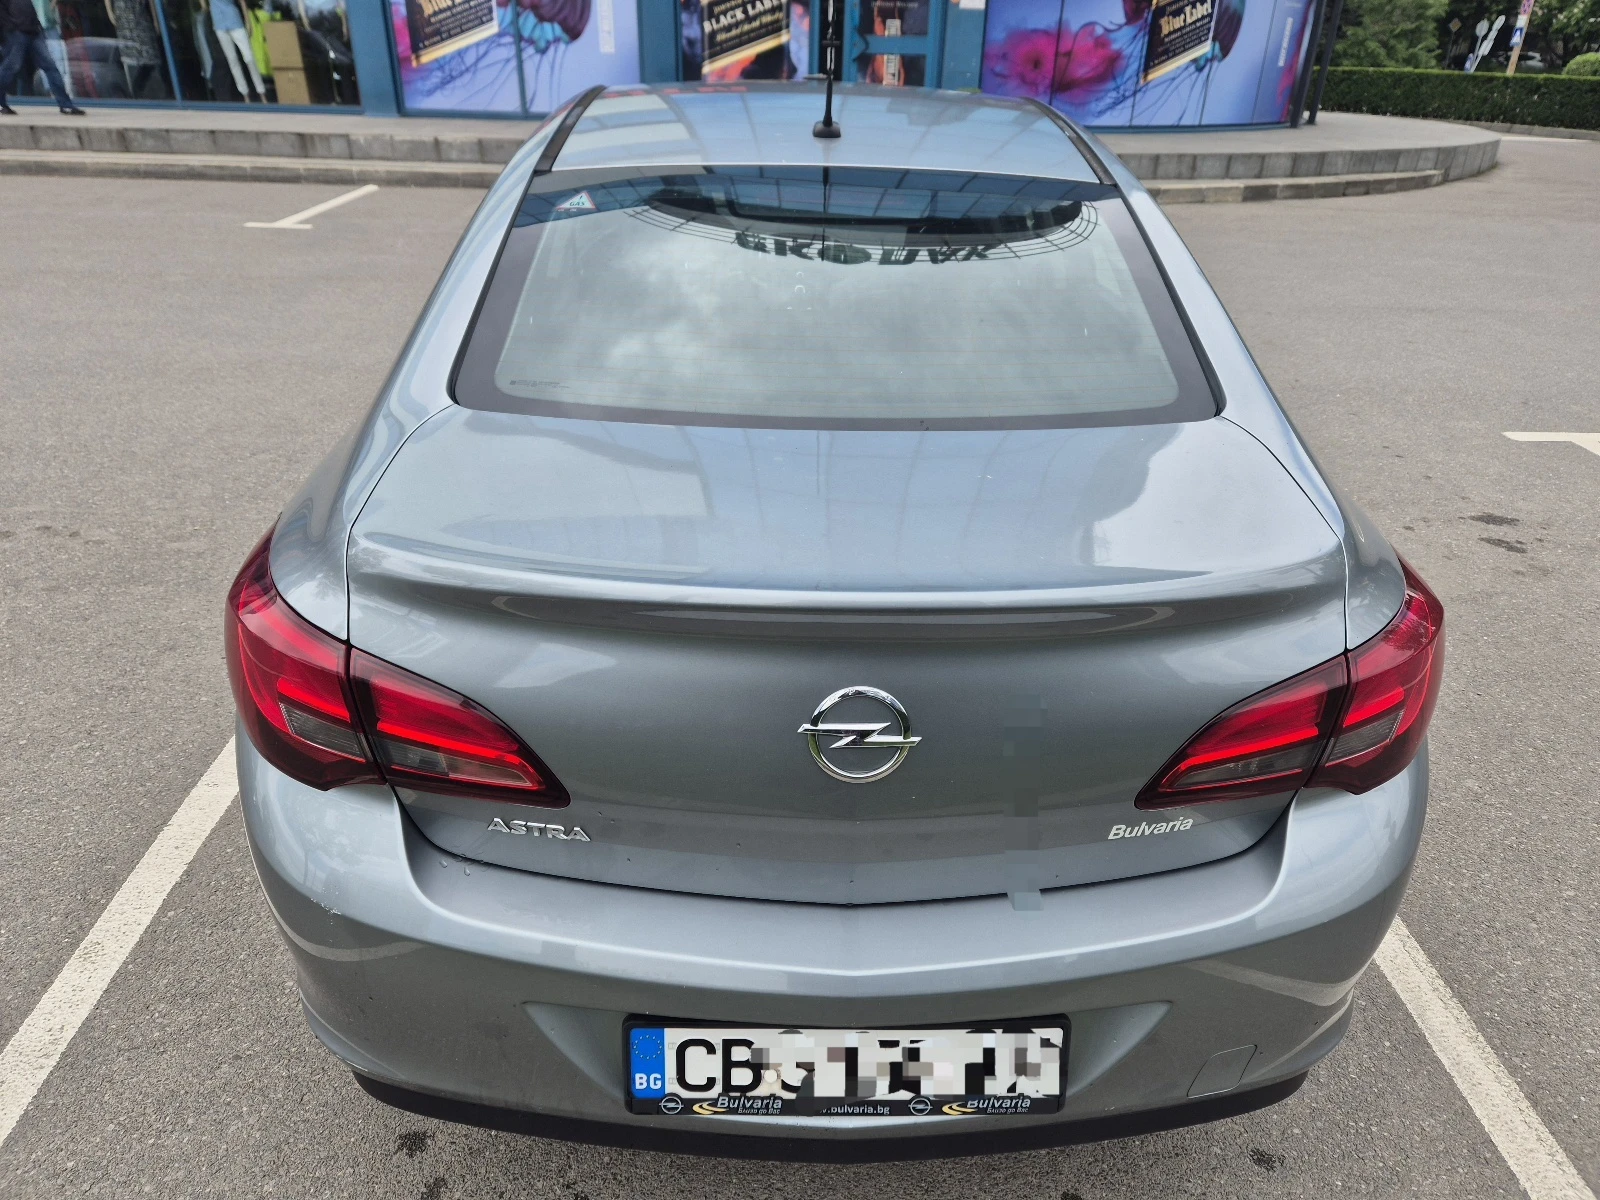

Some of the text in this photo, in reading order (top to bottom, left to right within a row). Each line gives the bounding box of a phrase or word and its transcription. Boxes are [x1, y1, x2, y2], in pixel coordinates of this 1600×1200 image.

[703, 7, 745, 33] BLACK
[1184, 0, 1212, 25] Label
[487, 817, 592, 842] ASTRA
[1107, 816, 1194, 840] Bulvaria
[634, 1073, 663, 1090] BG
[717, 1096, 782, 1109] Bulvaria
[966, 1096, 1031, 1108] Bulvaria
